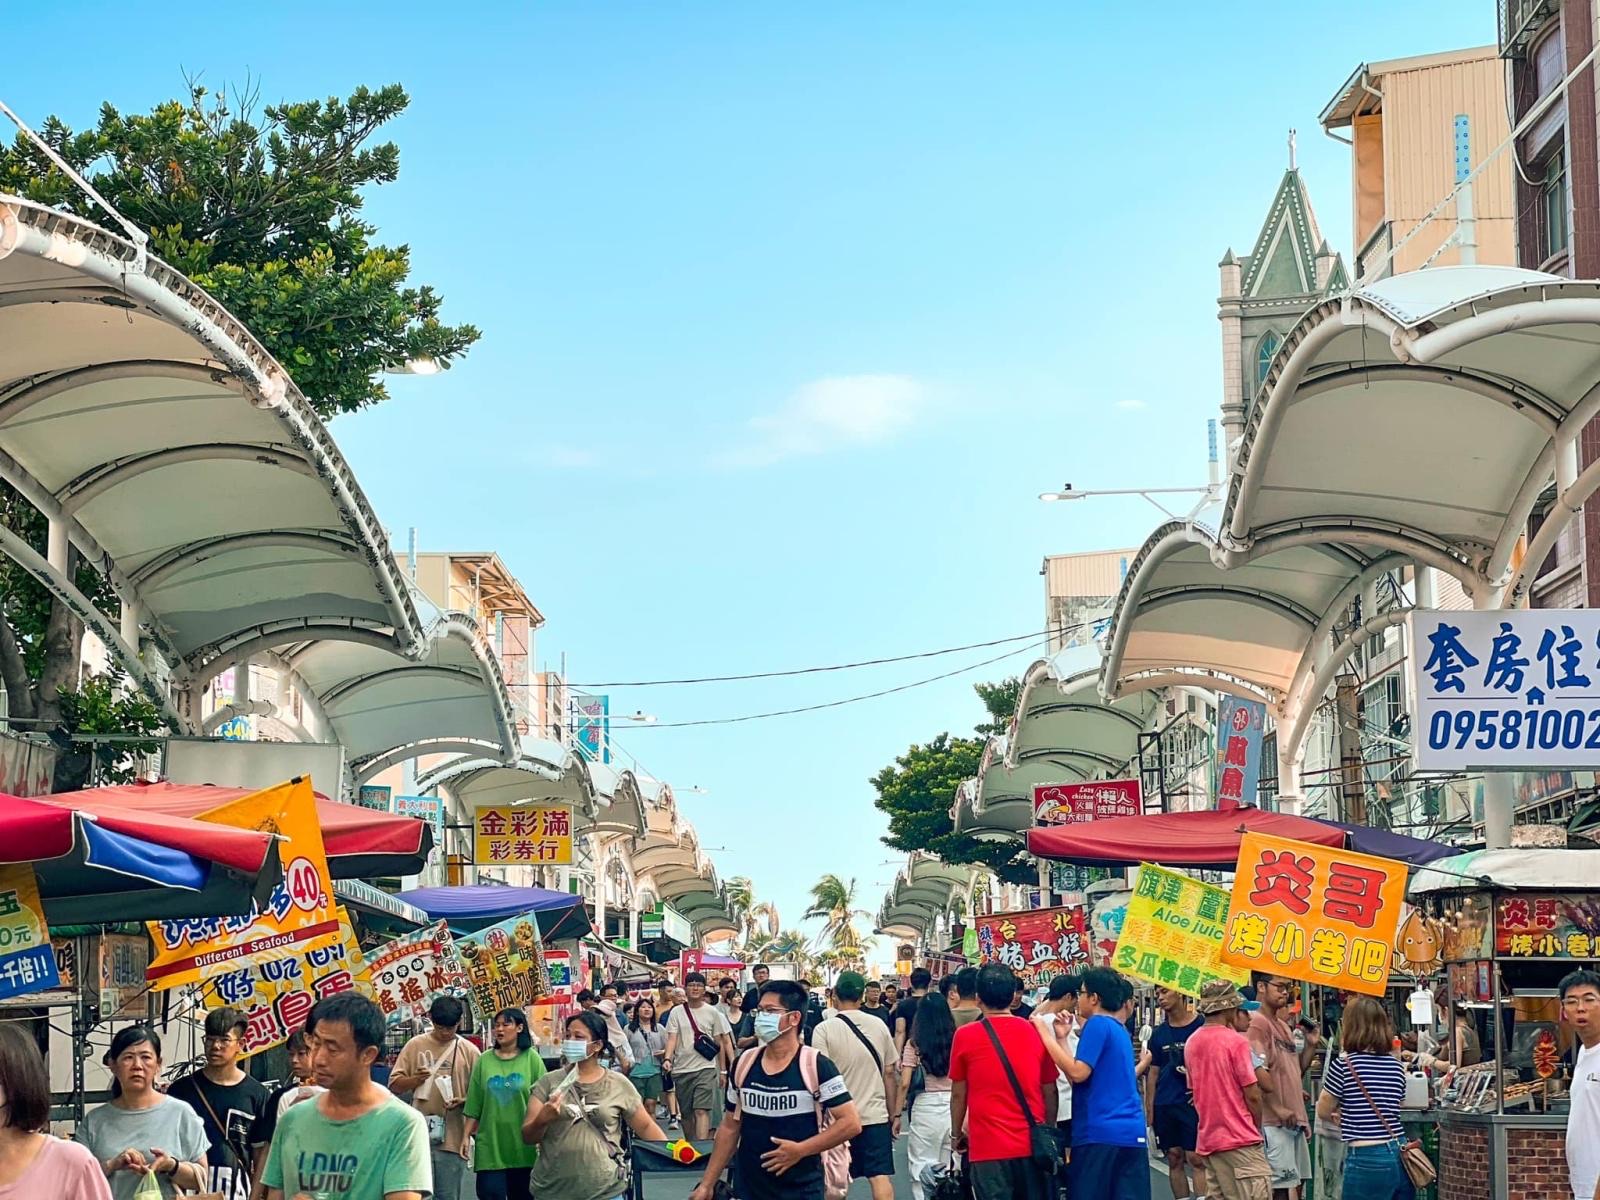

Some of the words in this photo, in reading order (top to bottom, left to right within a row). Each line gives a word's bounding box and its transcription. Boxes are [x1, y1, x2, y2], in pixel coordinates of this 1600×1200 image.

[1423, 622, 1600, 693] 套房住
[479, 810, 570, 837] 金彩滿
[489, 839, 560, 861] 彩券行
[292, 866, 318, 904] 40
[1249, 849, 1388, 929] 炎哥
[999, 912, 1075, 940] 台北
[1152, 907, 1191, 928] Aloe
[1190, 920, 1226, 940] juic
[1503, 897, 1560, 930] 炎哥
[194, 945, 245, 968] Different
[250, 932, 295, 952] Seafood
[1227, 911, 1388, 983] 烤小卷吧
[0, 955, 49, 988] 千倍!!
[742, 1091, 798, 1111] TOWARD
